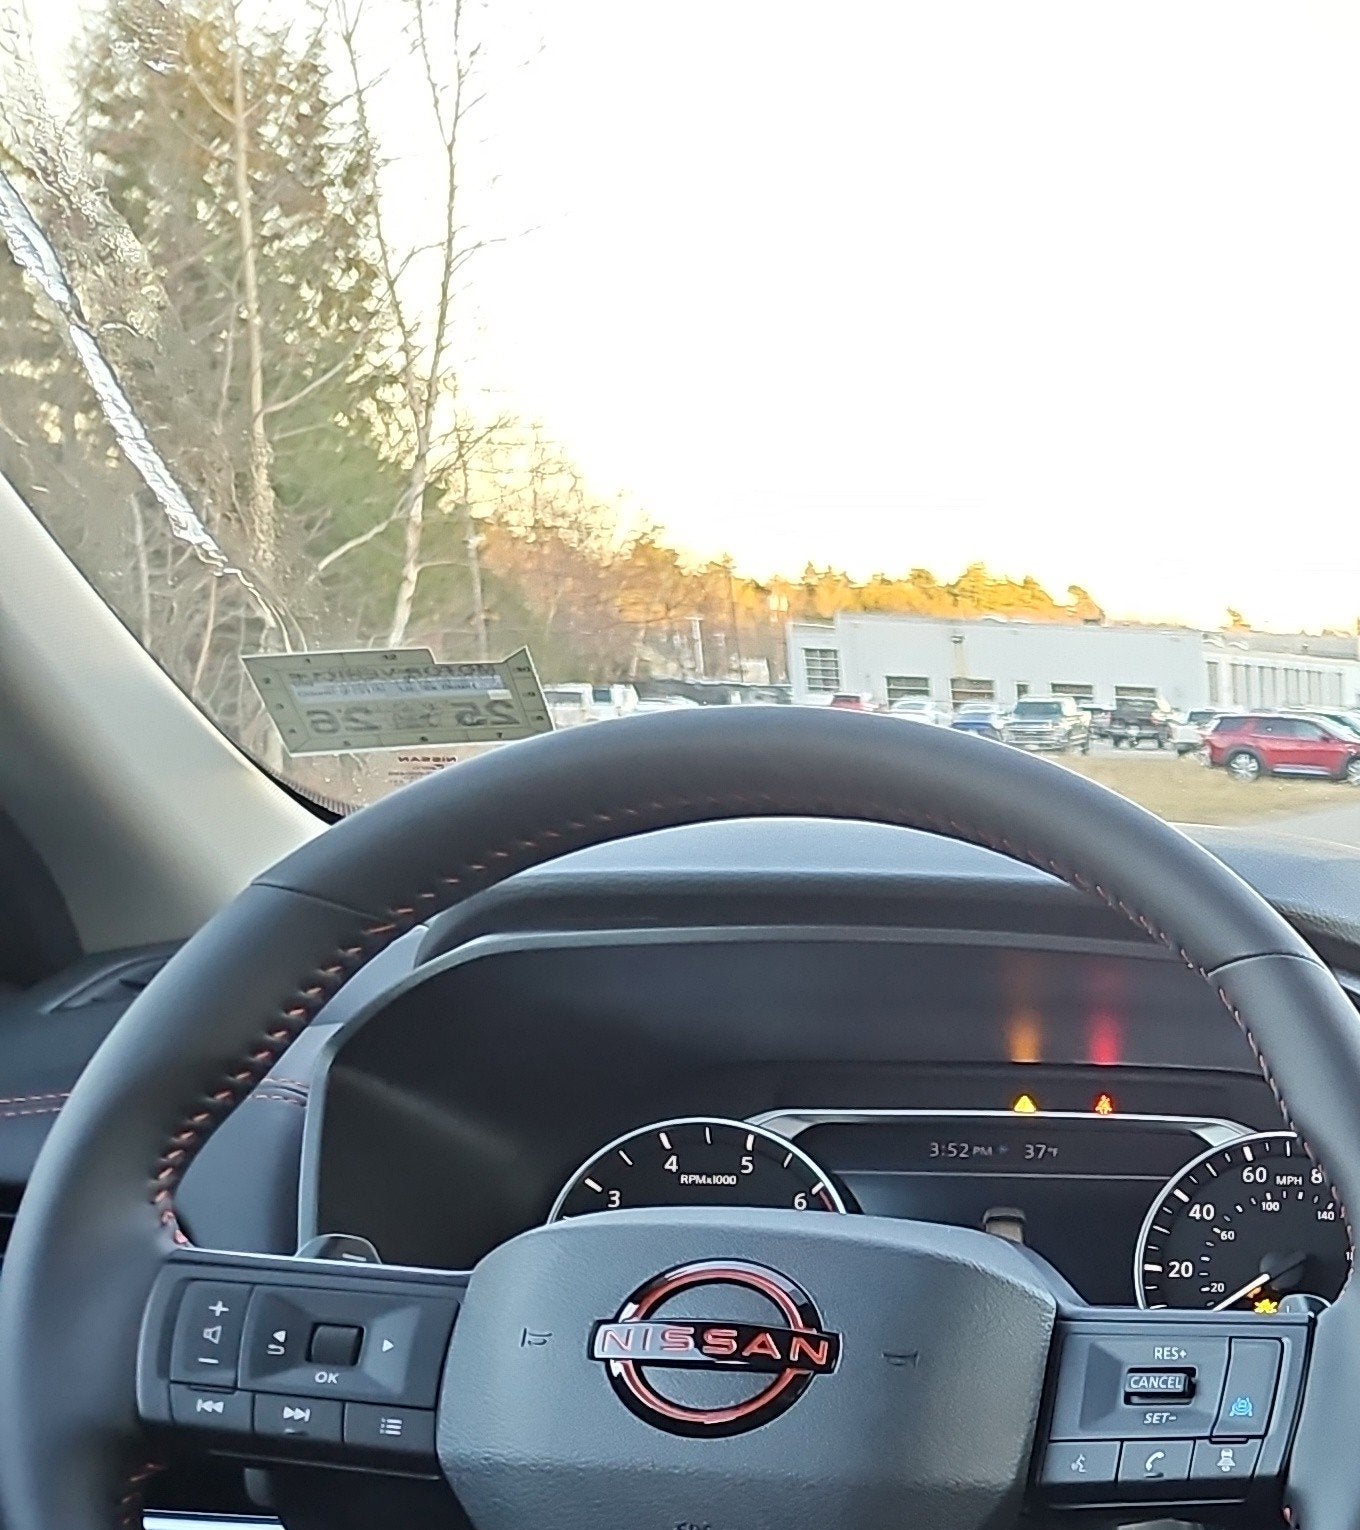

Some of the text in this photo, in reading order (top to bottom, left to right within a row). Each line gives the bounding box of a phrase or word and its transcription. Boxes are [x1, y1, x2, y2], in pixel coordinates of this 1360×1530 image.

[930, 1143, 993, 1158] 3:52 PM
[664, 1155, 678, 1172] 4
[741, 1156, 754, 1174] 5
[1242, 1167, 1267, 1183] 60
[1276, 1175, 1302, 1186] MPH
[608, 1190, 621, 1208] 3
[794, 1193, 807, 1210] 6
[1262, 1202, 1280, 1211] 100
[1188, 1203, 1215, 1220] 40
[1317, 1211, 1335, 1220] 140
[1220, 1231, 1235, 1240] 60
[1168, 1262, 1193, 1278] 20
[1211, 1283, 1224, 1293] 20
[601, 1326, 829, 1365] NISSAN
[314, 1371, 339, 1384] OK
[1130, 1375, 1182, 1389] CANCEL
